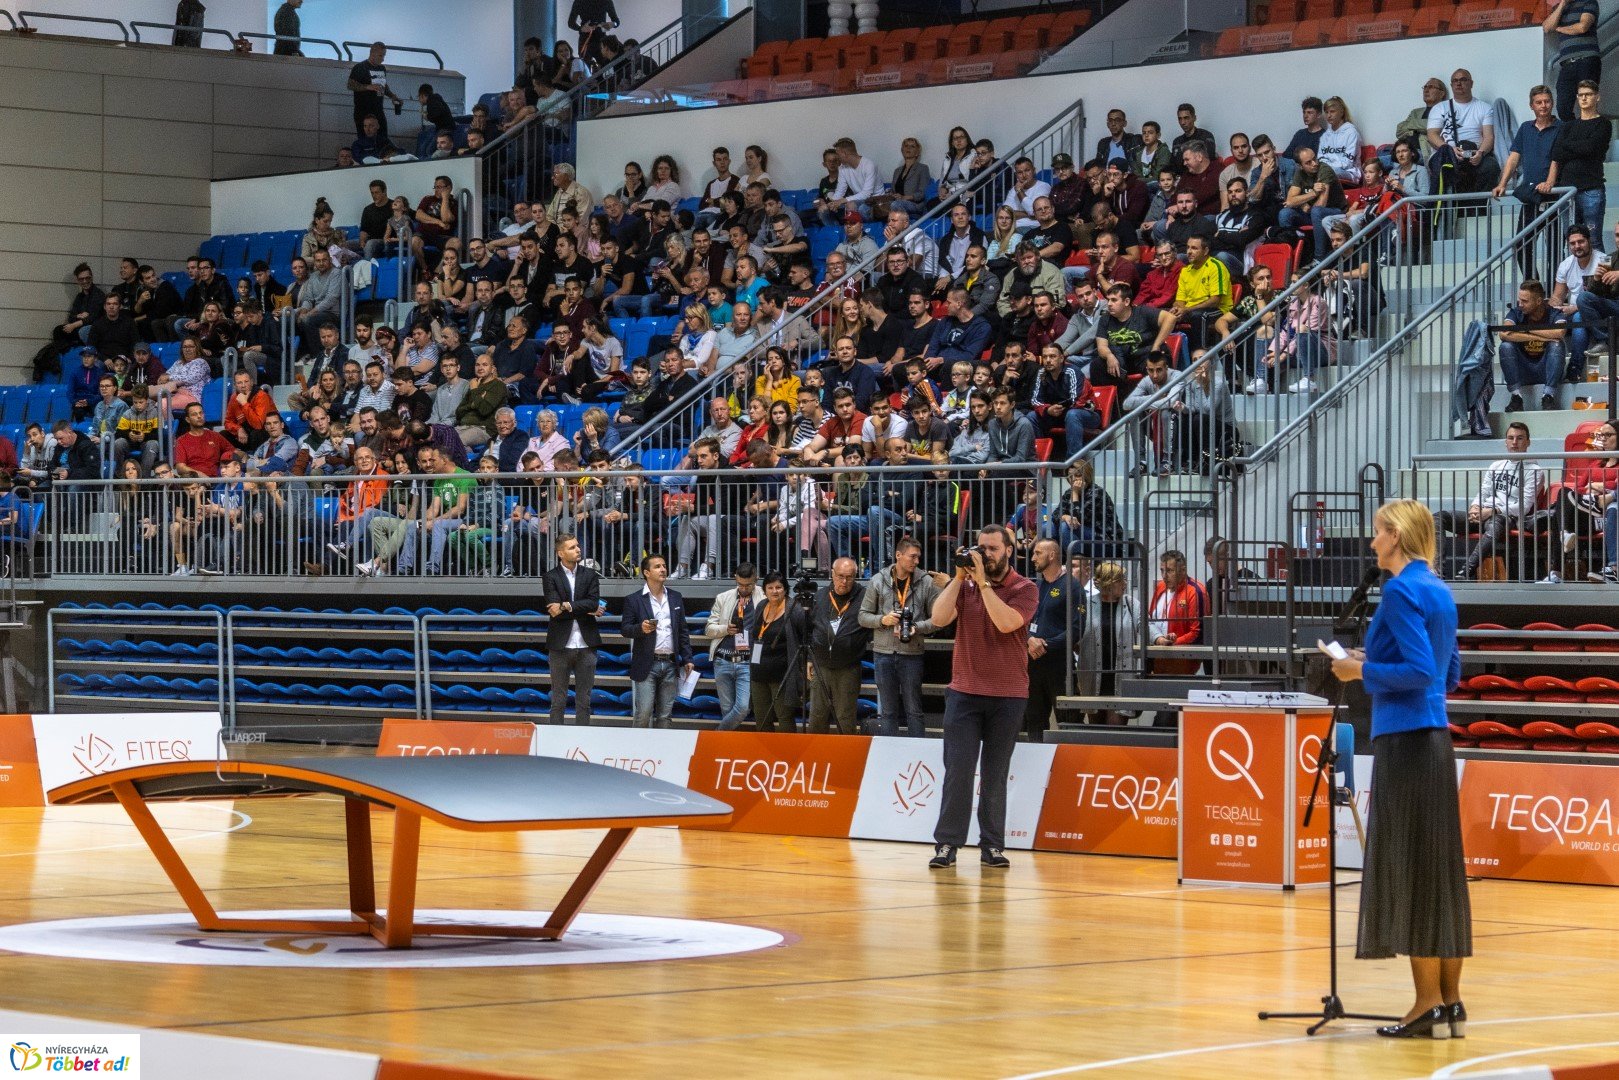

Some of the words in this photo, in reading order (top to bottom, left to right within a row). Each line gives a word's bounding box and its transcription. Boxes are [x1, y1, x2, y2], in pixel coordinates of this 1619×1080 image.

[1156, 43, 1187, 53] CHELIN
[715, 758, 836, 802] TEQBALL
[774, 798, 797, 807] WORLD
[804, 800, 829, 808] CURVED
[1076, 773, 1179, 820] TEQBA
[1144, 816, 1168, 825] WORLD
[1204, 805, 1264, 824] TEQBALL
[1489, 793, 1619, 845] TEQBA
[1571, 841, 1601, 851] WORLD
[1603, 842, 1610, 851] IS
